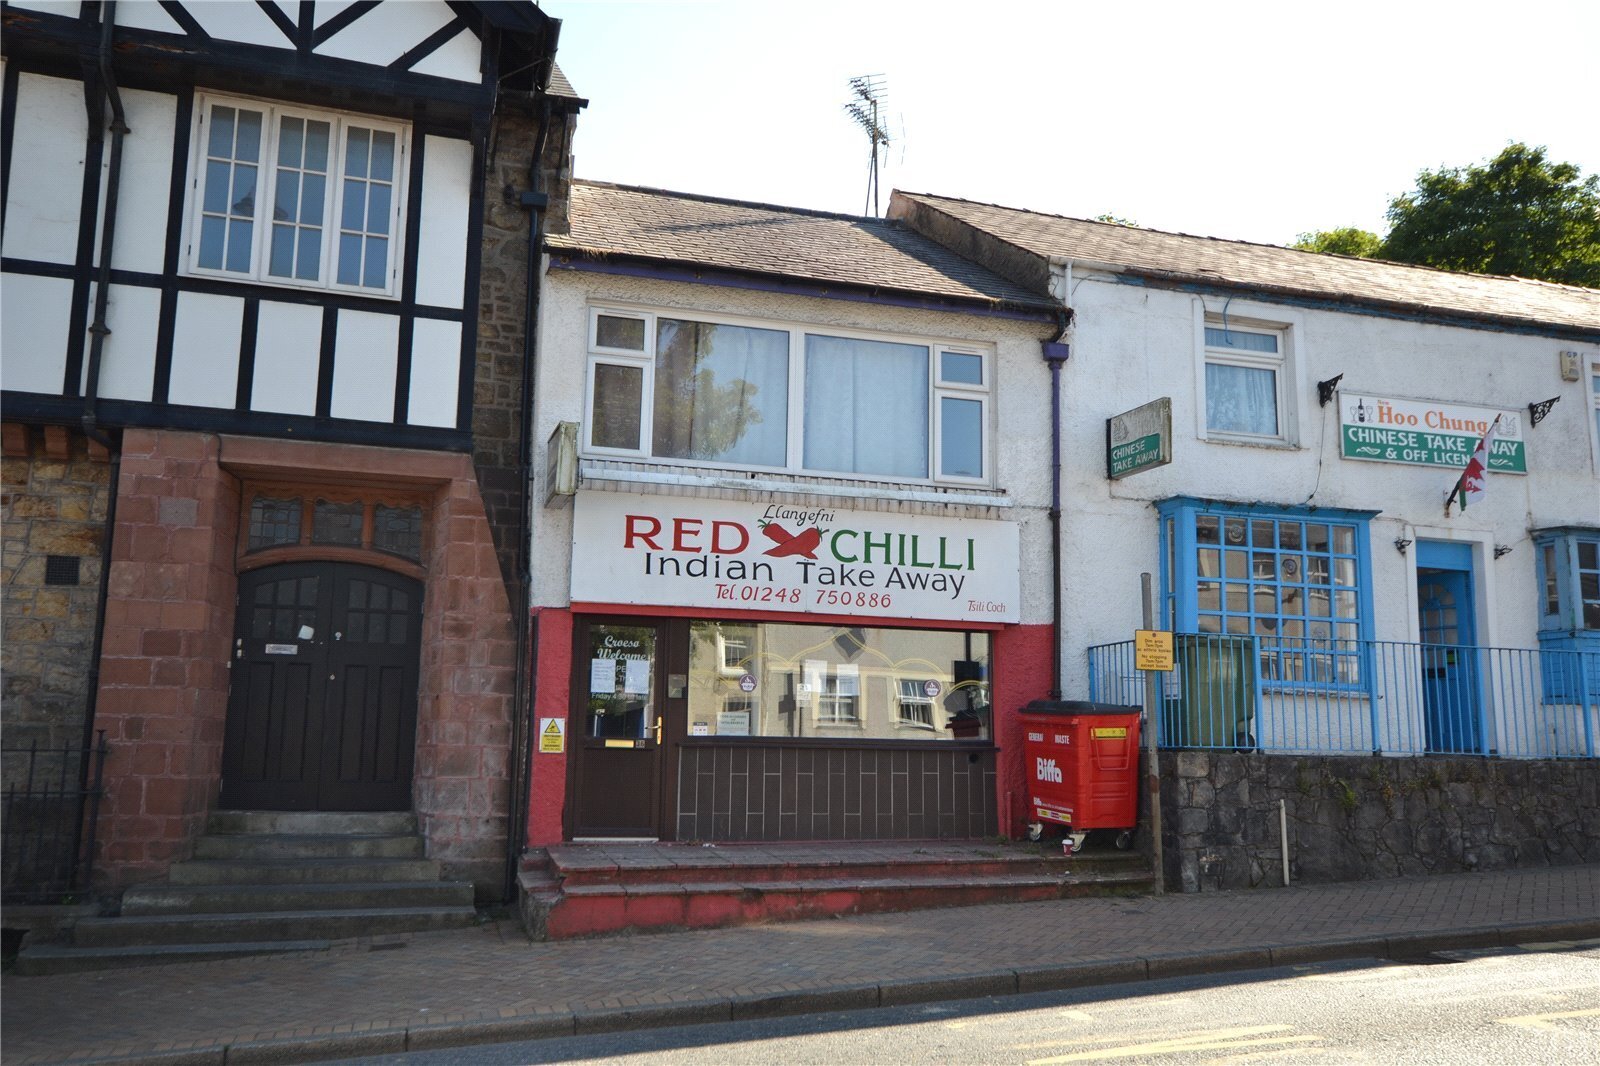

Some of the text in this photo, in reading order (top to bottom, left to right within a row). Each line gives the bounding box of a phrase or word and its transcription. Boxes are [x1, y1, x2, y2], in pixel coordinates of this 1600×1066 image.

[1377, 405, 1488, 436] Hoo Chung
[1348, 427, 1419, 447] CHINESE
[1424, 434, 1467, 451] TAKE
[1112, 440, 1145, 460] CHINESE
[1113, 448, 1159, 473] TAKE AWAY
[1385, 447, 1471, 466] & OFF LICEN
[763, 504, 835, 526] Llangefni
[624, 514, 975, 571] RED CHILLI
[644, 552, 965, 599] Indian Take Away
[816, 589, 891, 608] 750886
[967, 600, 1006, 613] Tsili Coch
[604, 635, 640, 648] Croeso
[597, 648, 647, 661] Welcome
[1055, 734, 1070, 745] WASTE
[1036, 757, 1062, 783] Biffa
